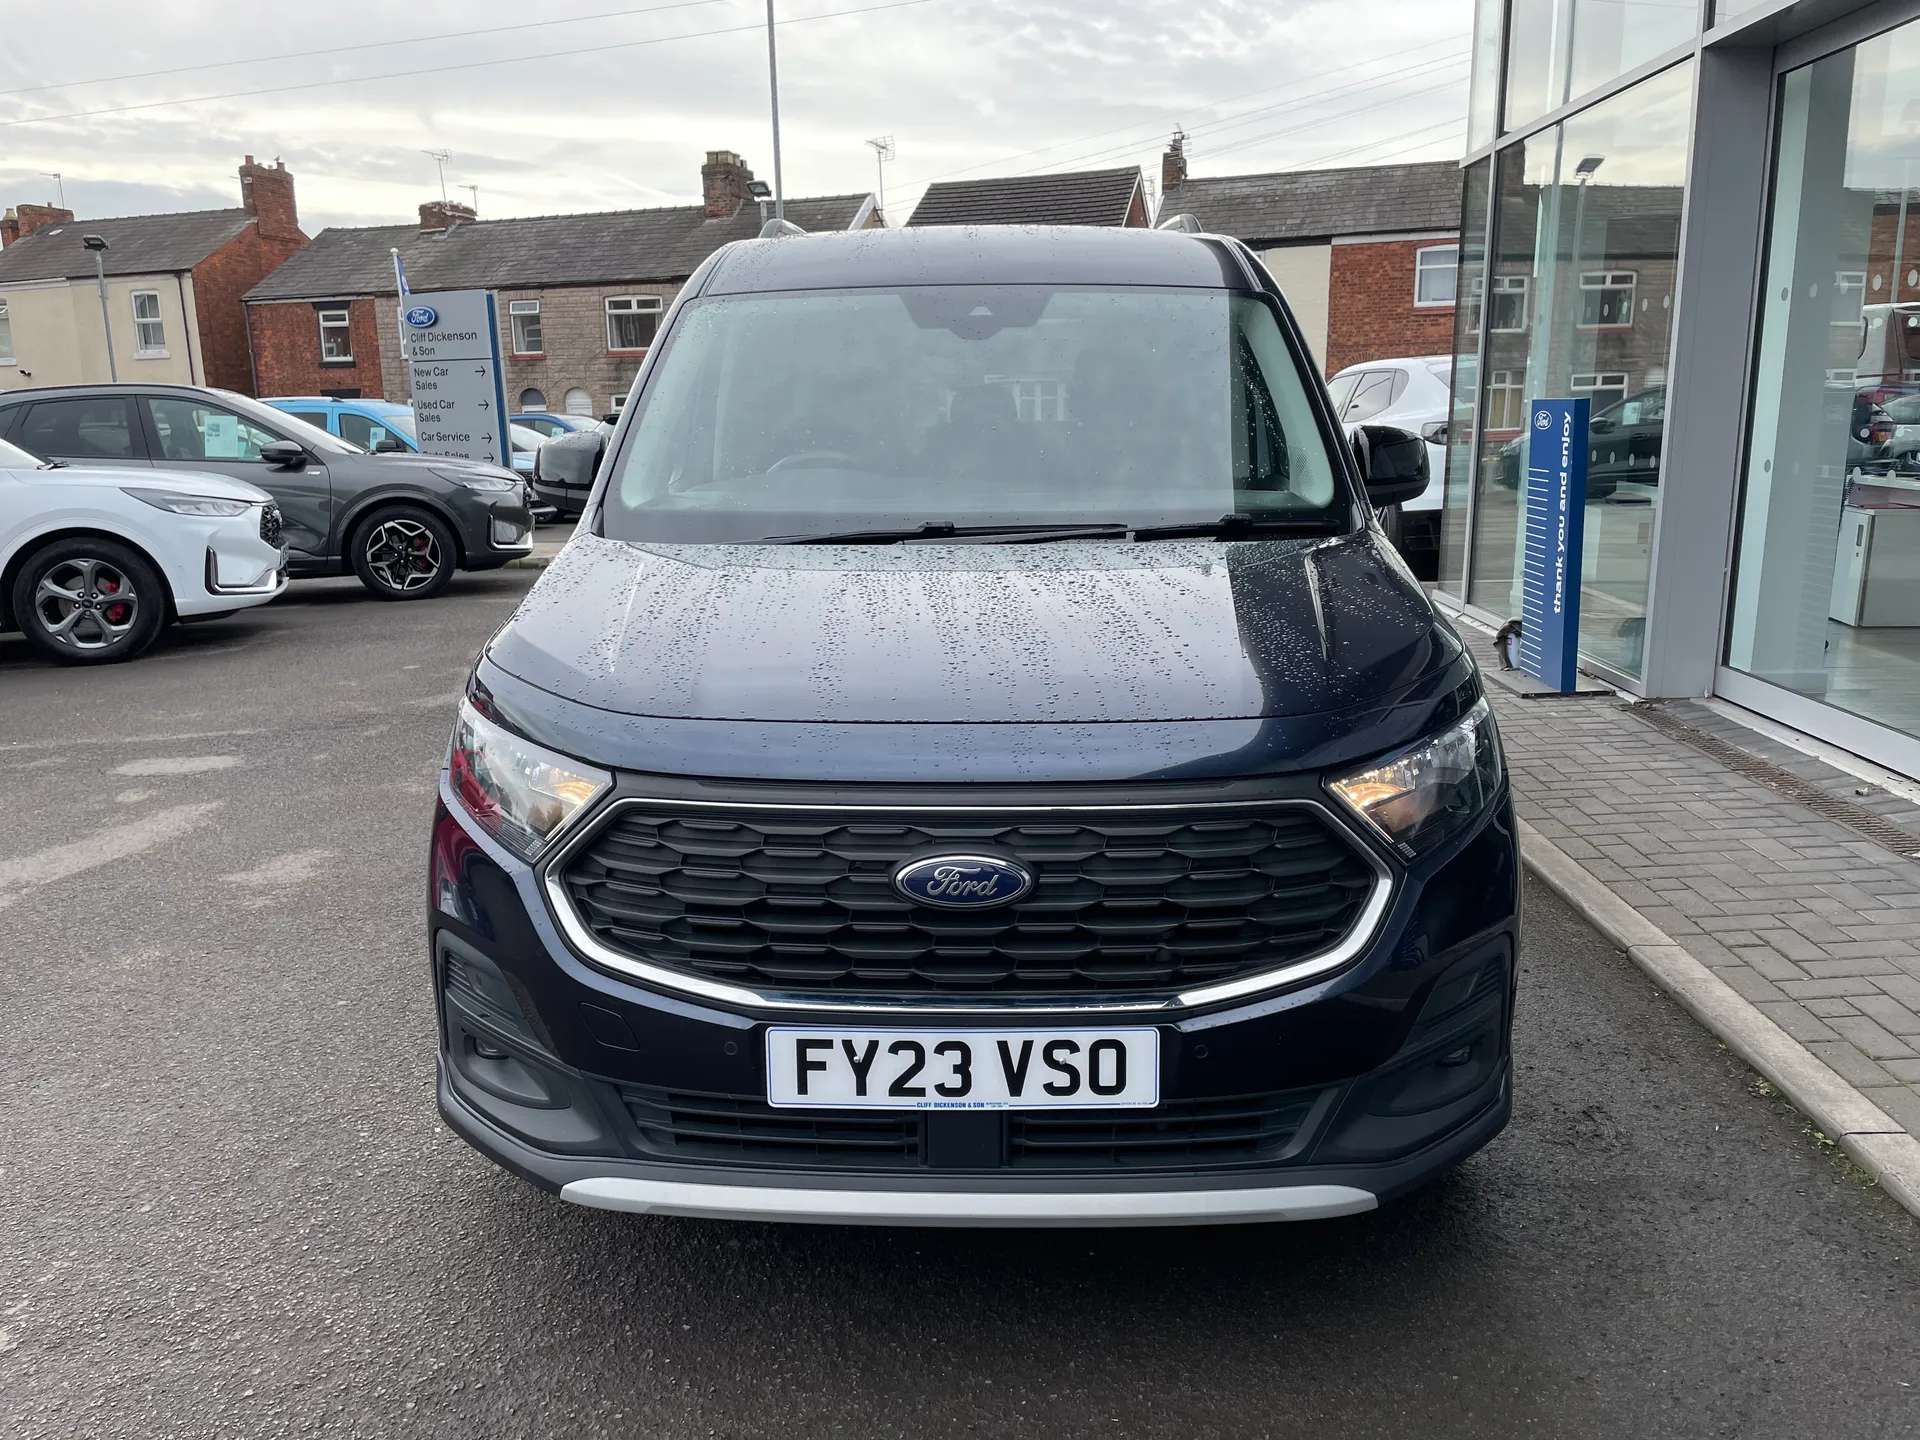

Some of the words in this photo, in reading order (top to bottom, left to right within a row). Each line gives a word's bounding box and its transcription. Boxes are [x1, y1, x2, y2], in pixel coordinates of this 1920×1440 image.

[411, 309, 429, 324] Ford
[410, 332, 426, 343] Cliff
[427, 331, 478, 342] Dickenson
[412, 346, 418, 356] &
[418, 345, 436, 356] Son
[414, 367, 432, 377] New
[433, 366, 449, 377] Car
[415, 380, 438, 391] Sales
[417, 399, 438, 410] Used
[438, 399, 455, 409] Car
[419, 412, 441, 423] Sales
[421, 431, 435, 442] Car
[436, 431, 471, 442] Service
[1561, 411, 1572, 468] enjoy
[1559, 471, 1568, 512] and
[1557, 515, 1566, 553] you
[1554, 556, 1564, 614] thank
[926, 866, 1000, 897] Ford
[796, 1038, 973, 1098] FY23
[996, 1038, 1127, 1098] VSO
